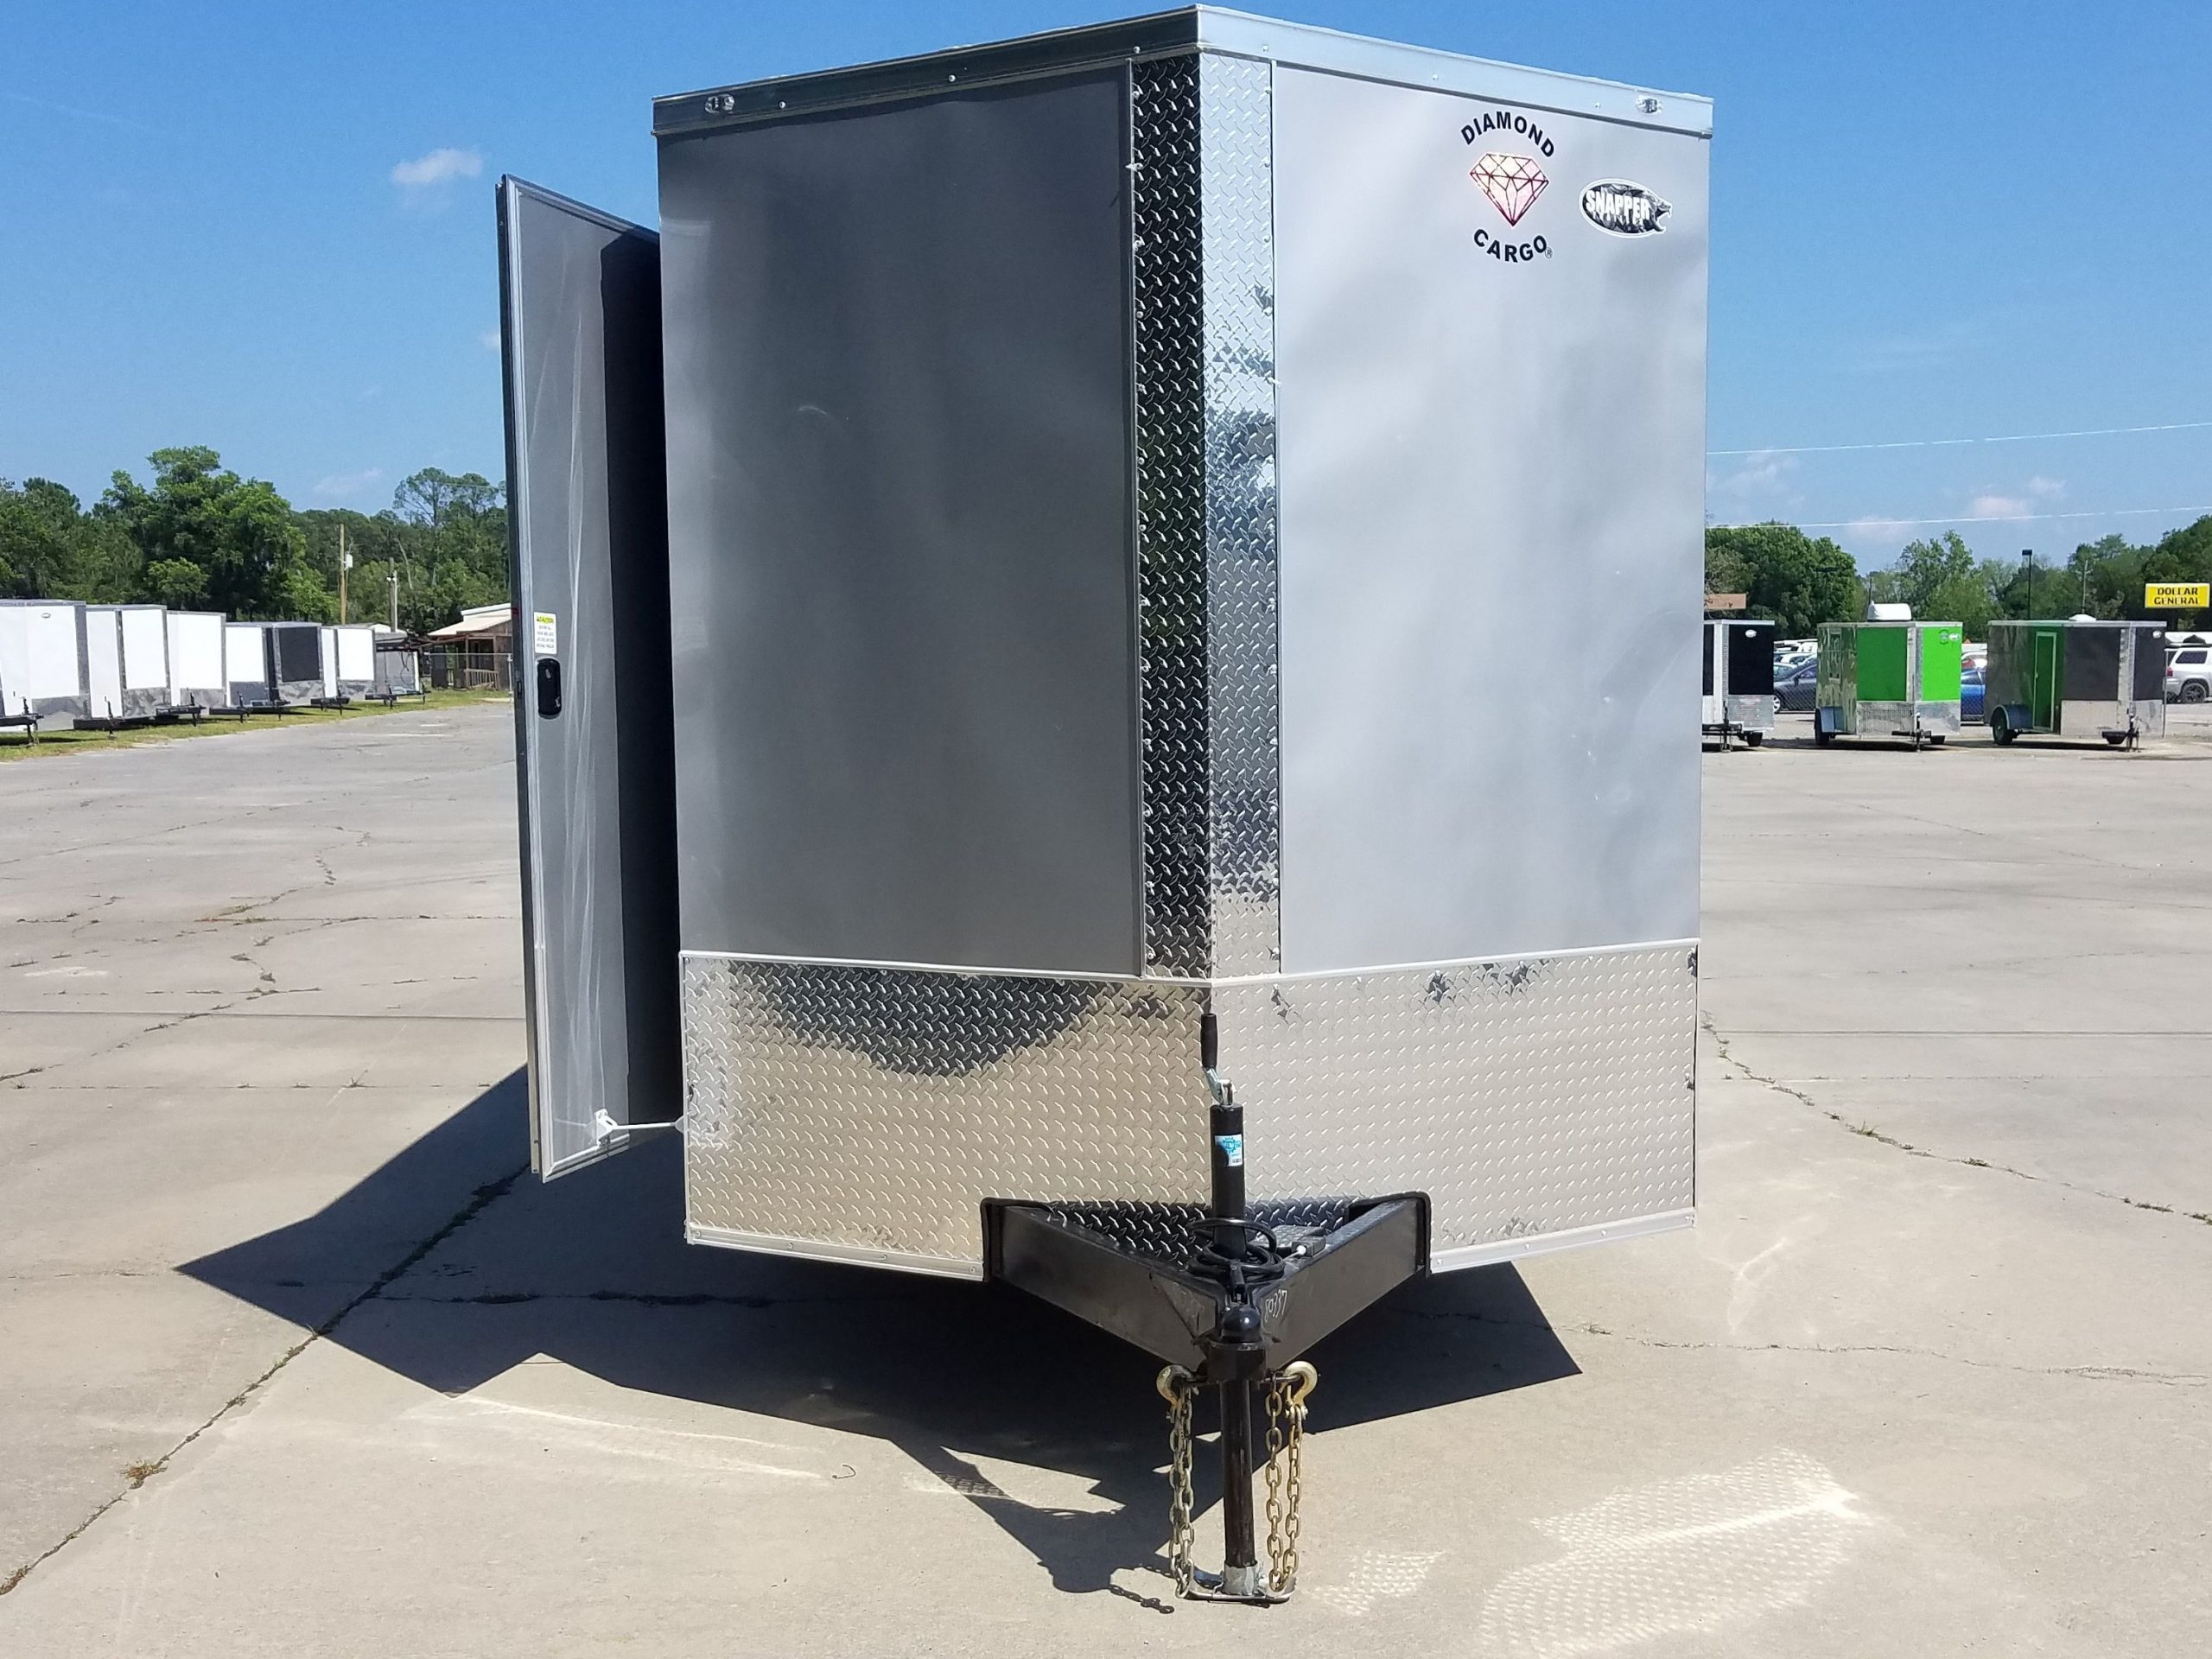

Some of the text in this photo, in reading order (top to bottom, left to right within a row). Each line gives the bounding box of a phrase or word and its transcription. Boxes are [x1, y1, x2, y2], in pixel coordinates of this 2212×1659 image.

[1460, 111, 1554, 157] DIAMOND
[1585, 188, 1651, 223] SNAPPER
[1473, 228, 1548, 263] CARGO
[2153, 596, 2199, 605] GENERAL
[2157, 587, 2199, 595] DOLLAR
